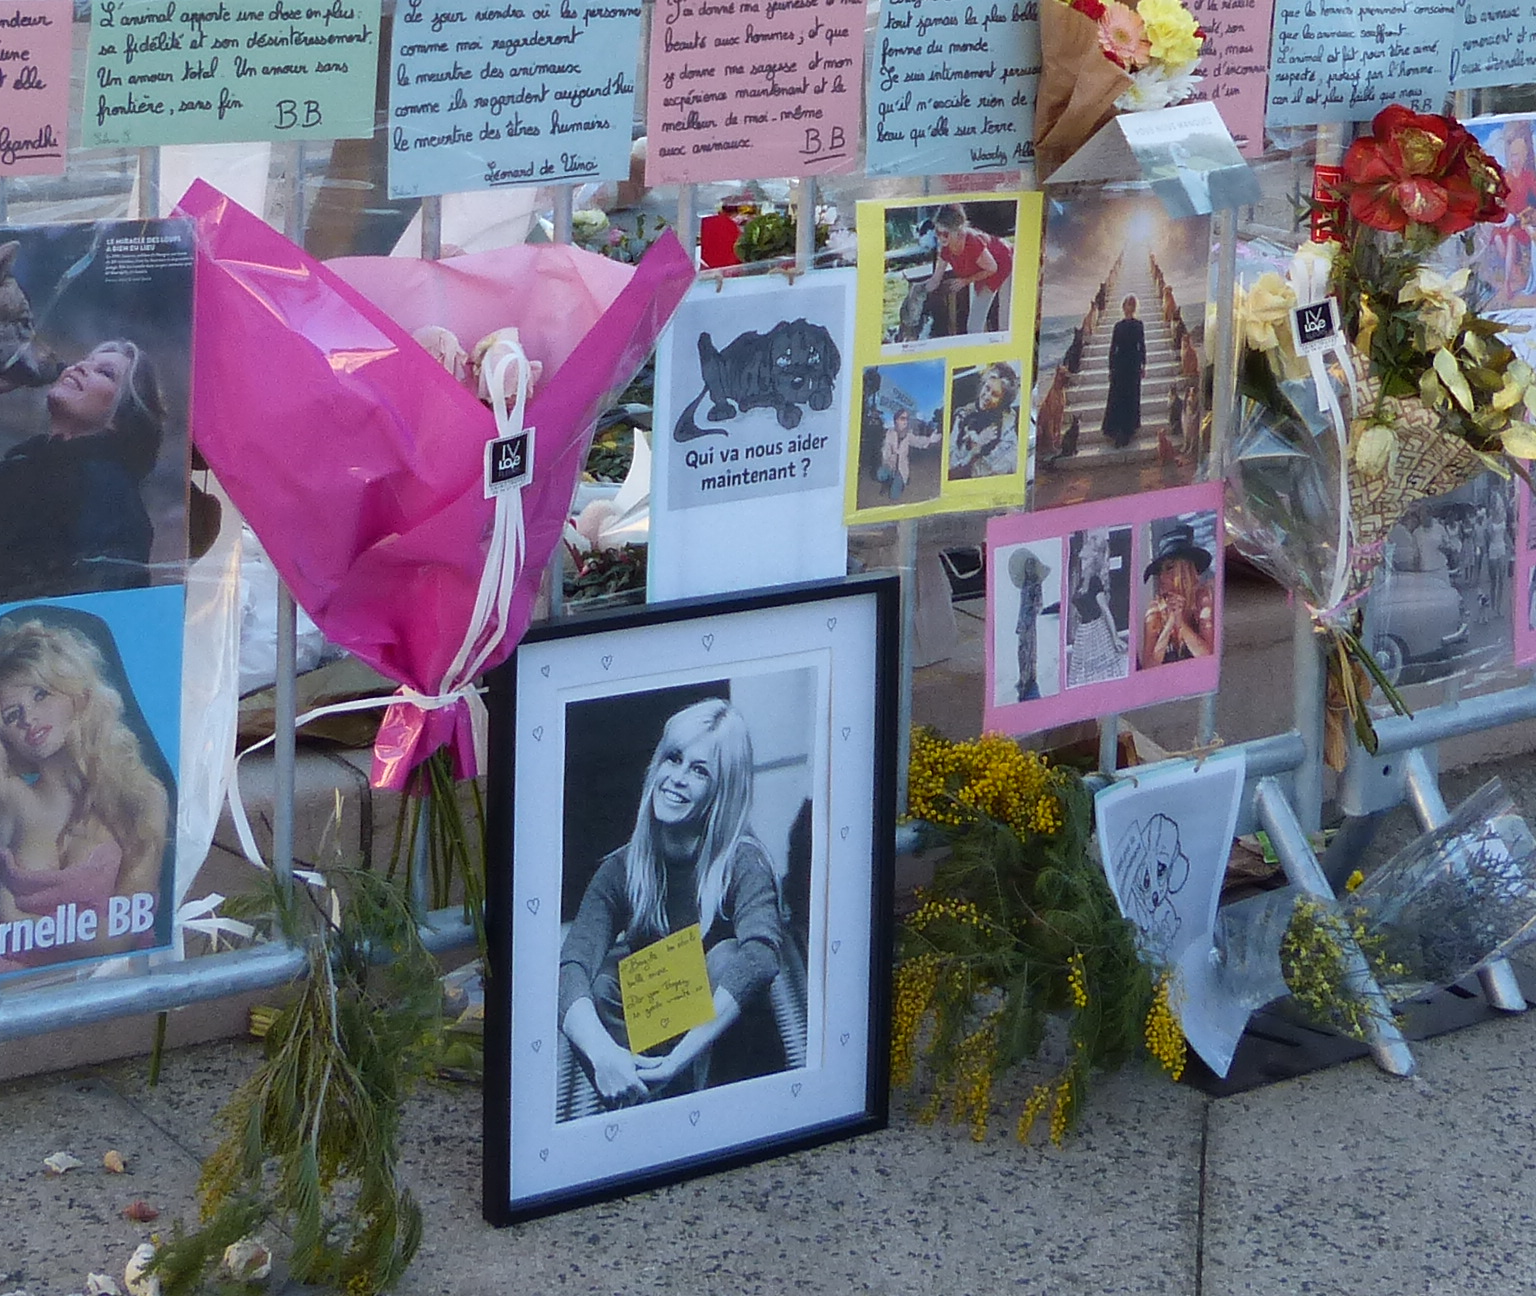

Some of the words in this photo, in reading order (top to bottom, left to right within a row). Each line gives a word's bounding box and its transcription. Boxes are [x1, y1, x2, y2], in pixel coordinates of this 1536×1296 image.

[100, 1, 175, 28] L'animal
[180, 2, 230, 32] apporte
[235, 9, 264, 22] une
[268, 1, 302, 21] chose
[305, 8, 321, 19] en
[431, 11, 467, 32] jour
[475, 4, 525, 22] viendra
[532, 4, 550, 20] où
[884, 12, 913, 29] tout
[916, 14, 959, 36] jamais
[965, 7, 978, 25] la
[982, 6, 1007, 32] plus
[98, 43, 117, 55] sa
[125, 30, 184, 64] fidélité
[190, 30, 207, 49] et
[213, 36, 239, 49] son
[400, 41, 449, 56] comme
[456, 36, 482, 51] moi
[492, 26, 583, 56] regarderont
[882, 37, 922, 66] femme
[927, 40, 943, 54] du
[13, 66, 46, 90] elle
[97, 67, 122, 88] Un
[128, 72, 173, 85] amour
[234, 56, 257, 78] Un
[262, 63, 308, 75] amour
[316, 60, 348, 73] sans
[397, 64, 410, 86] le
[416, 61, 473, 84] meurtre
[480, 62, 504, 78] des
[509, 61, 581, 78] animaux
[880, 64, 899, 91] Je
[903, 72, 925, 82] suis
[928, 61, 996, 81] intimement
[178, 99, 212, 111] sans
[218, 88, 244, 120] fin
[395, 102, 440, 117] comme
[448, 89, 468, 111] ils
[555, 72, 634, 107] aujourd'hui
[393, 127, 409, 152] le
[414, 124, 473, 149] meurtre
[480, 122, 501, 141] des
[506, 111, 540, 137] êtres
[540, 160, 554, 174] de
[561, 153, 598, 173] Vinci
[971, 146, 1007, 163] Woody
[685, 446, 714, 469] Qui
[719, 448, 739, 463] va
[745, 441, 783, 459] nous
[787, 433, 828, 453] aider
[701, 461, 797, 491] maintenant
[801, 457, 811, 478] ?
[108, 892, 154, 937] BB
